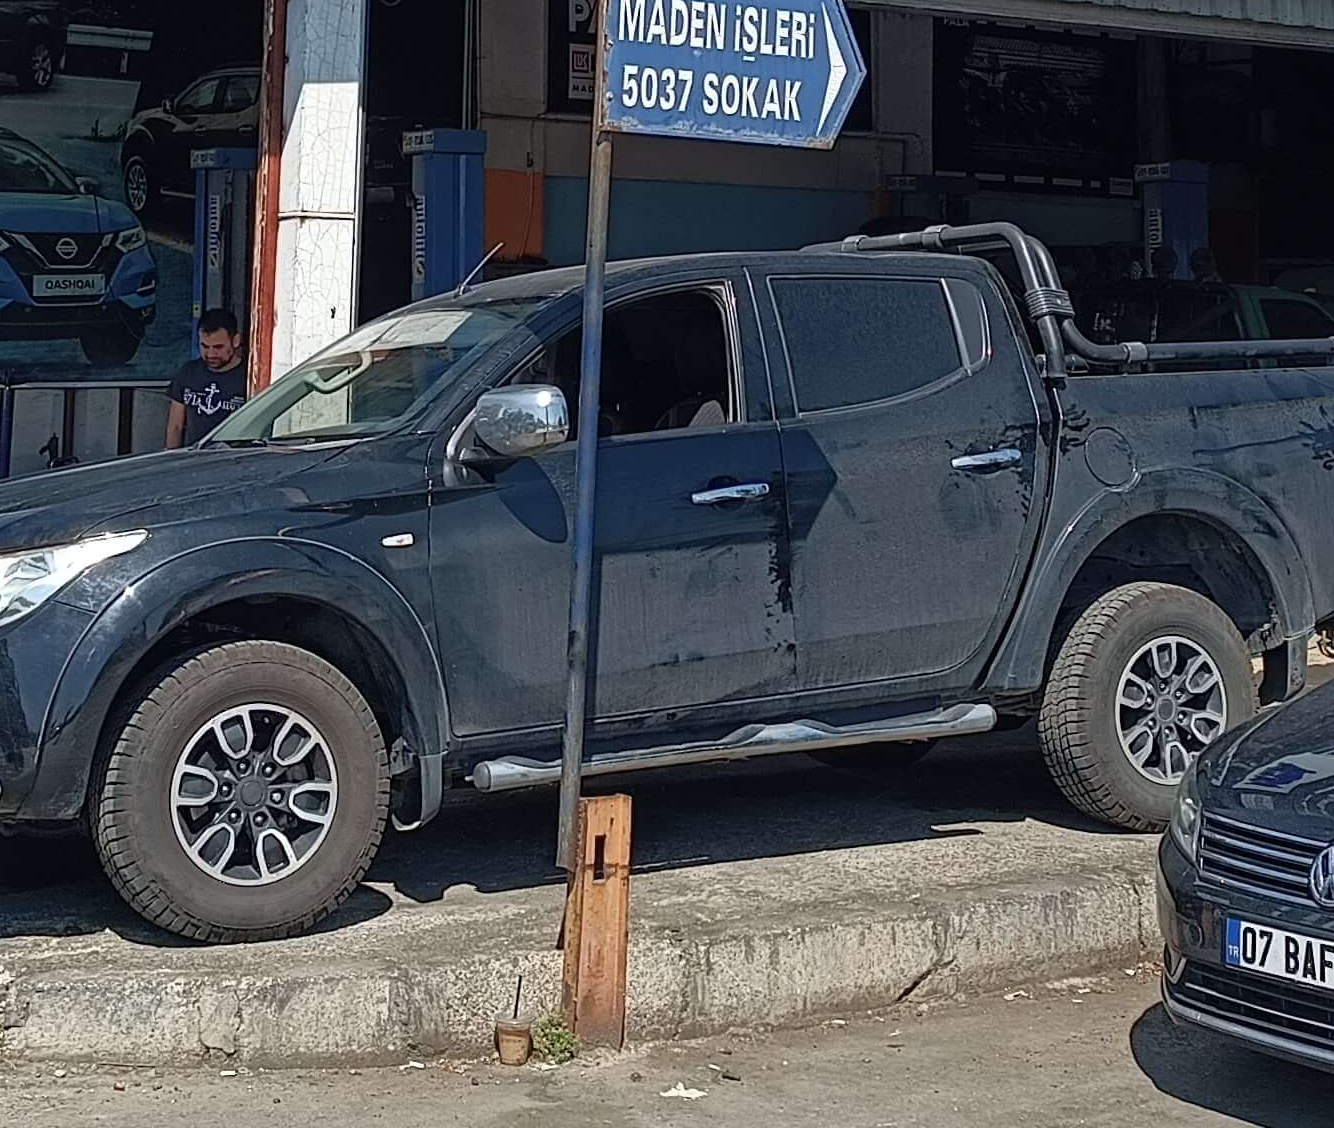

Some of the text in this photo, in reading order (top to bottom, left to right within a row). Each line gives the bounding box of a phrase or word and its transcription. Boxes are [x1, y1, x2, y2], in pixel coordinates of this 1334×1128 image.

[621, 63, 802, 123] 5037 SOKAK
[44, 276, 96, 293] QASHQAI
[1242, 926, 1273, 968] 07
